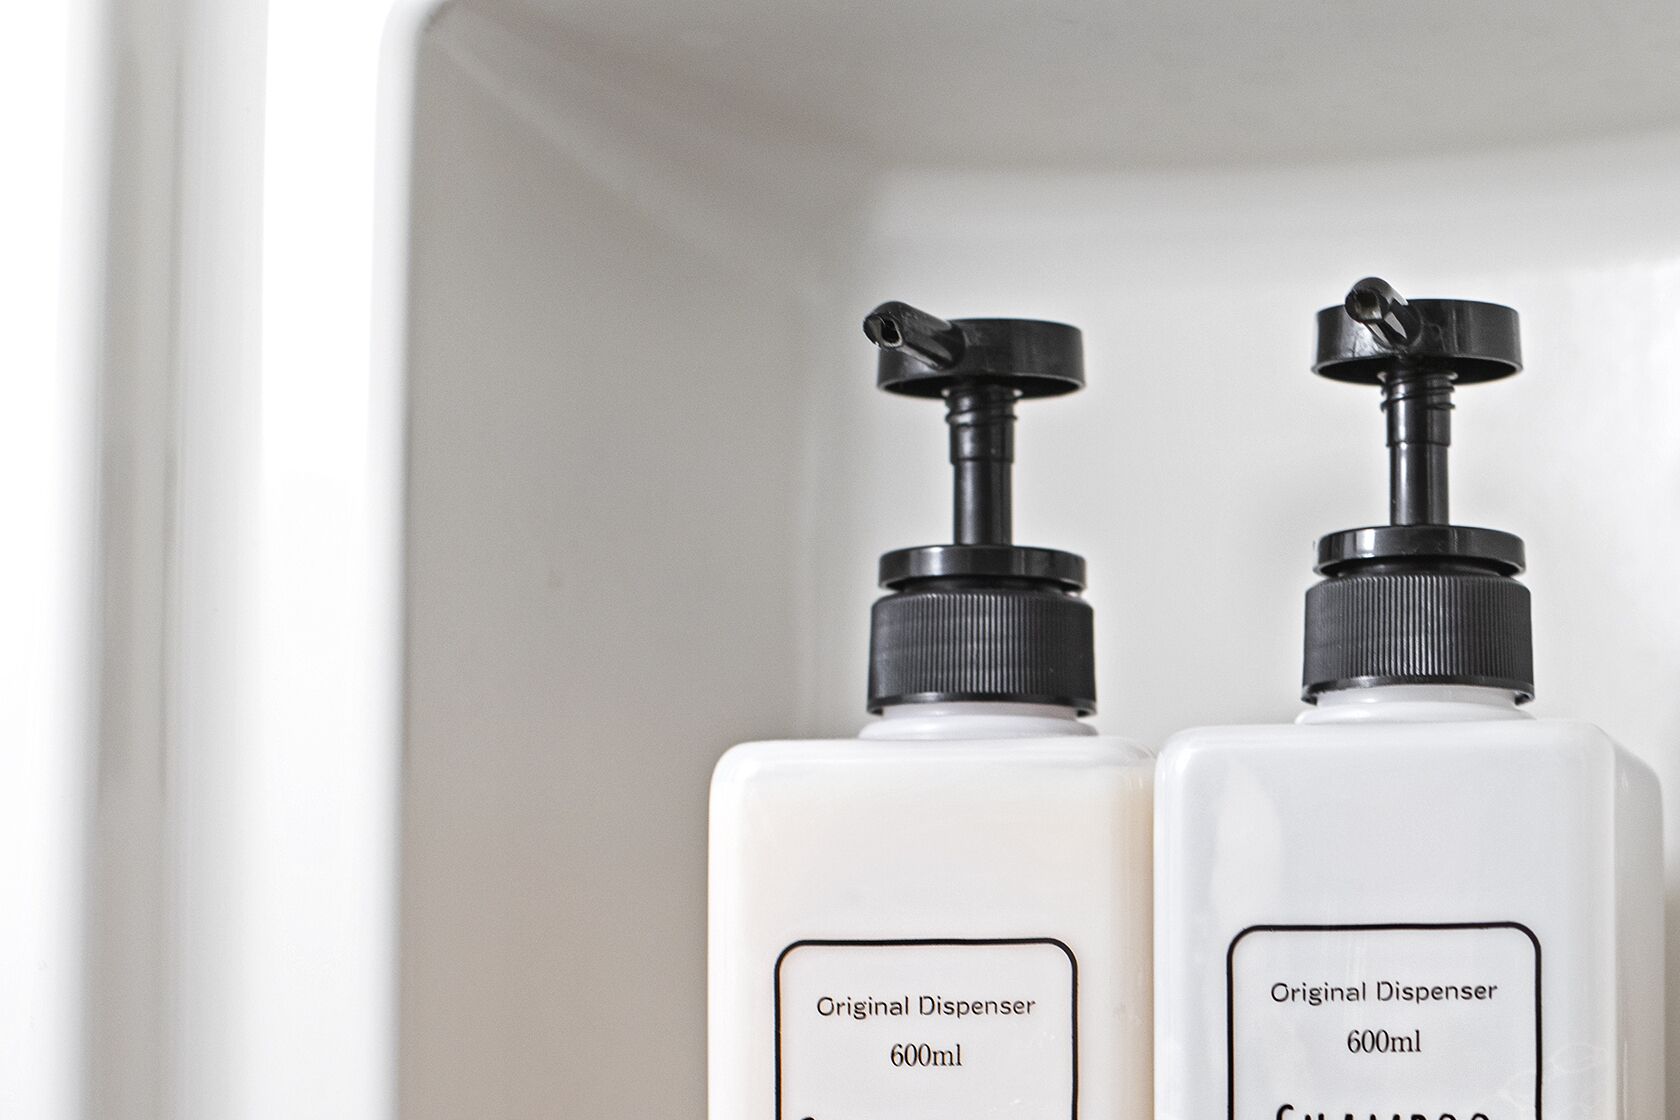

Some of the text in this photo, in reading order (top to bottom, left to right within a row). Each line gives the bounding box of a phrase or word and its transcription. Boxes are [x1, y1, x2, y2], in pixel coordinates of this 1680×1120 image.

[1271, 981, 1498, 1006] Original Dispenser
[817, 995, 1036, 1020] Original Dispenser
[1347, 1029, 1421, 1054] 600ml
[890, 1043, 963, 1068] 600ml
